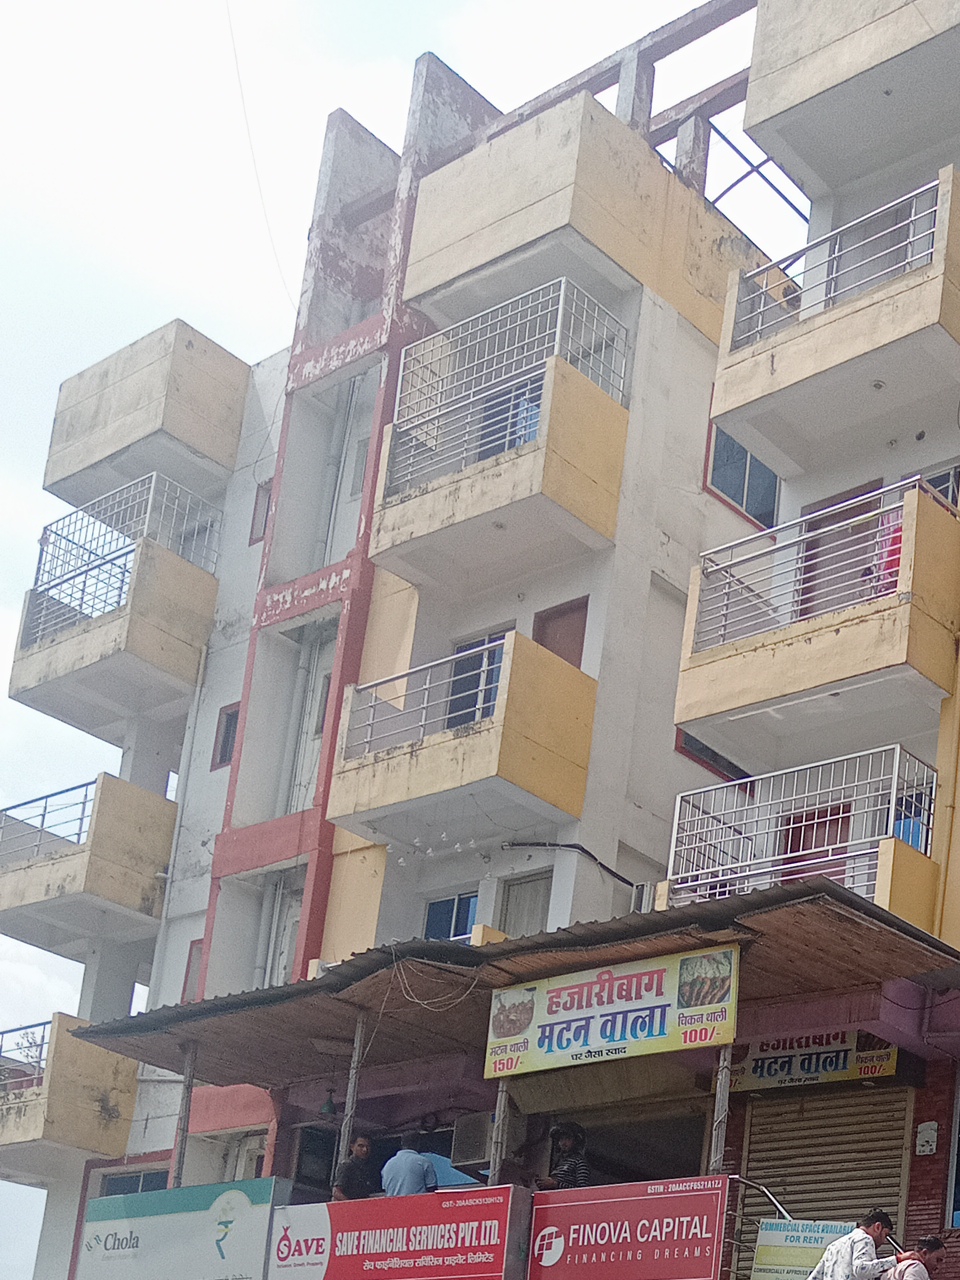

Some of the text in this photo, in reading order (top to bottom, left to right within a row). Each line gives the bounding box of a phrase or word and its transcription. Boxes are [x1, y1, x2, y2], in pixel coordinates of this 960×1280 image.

[546, 967, 667, 1016] हजारीबाग
[678, 1007, 728, 1028] चिकन थाली
[537, 1003, 672, 1054] मटन वाला
[681, 1026, 722, 1045] 100/-
[489, 1039, 529, 1057] मटन थाली
[492, 1055, 525, 1073] 150/-
[751, 1048, 852, 1079] मटन वाला
[858, 1064, 887, 1076] 100/-
[647, 1185, 664, 1194] GSTIN
[568, 1215, 713, 1247] FINOVA CAPITAL
[760, 1221, 800, 1233] COMMERCIAL
[801, 1223, 821, 1233] SPACE
[104, 1231, 139, 1251] Chola
[335, 1220, 500, 1256] SAVE FINANCIAL SERVICES PVT. LTD.
[785, 1235, 825, 1244] FOR RENT
[277, 1237, 325, 1261] SAVE
[467, 1252, 494, 1264] लिमिटेड
[566, 1245, 712, 1265] FINANCING DREAMS
